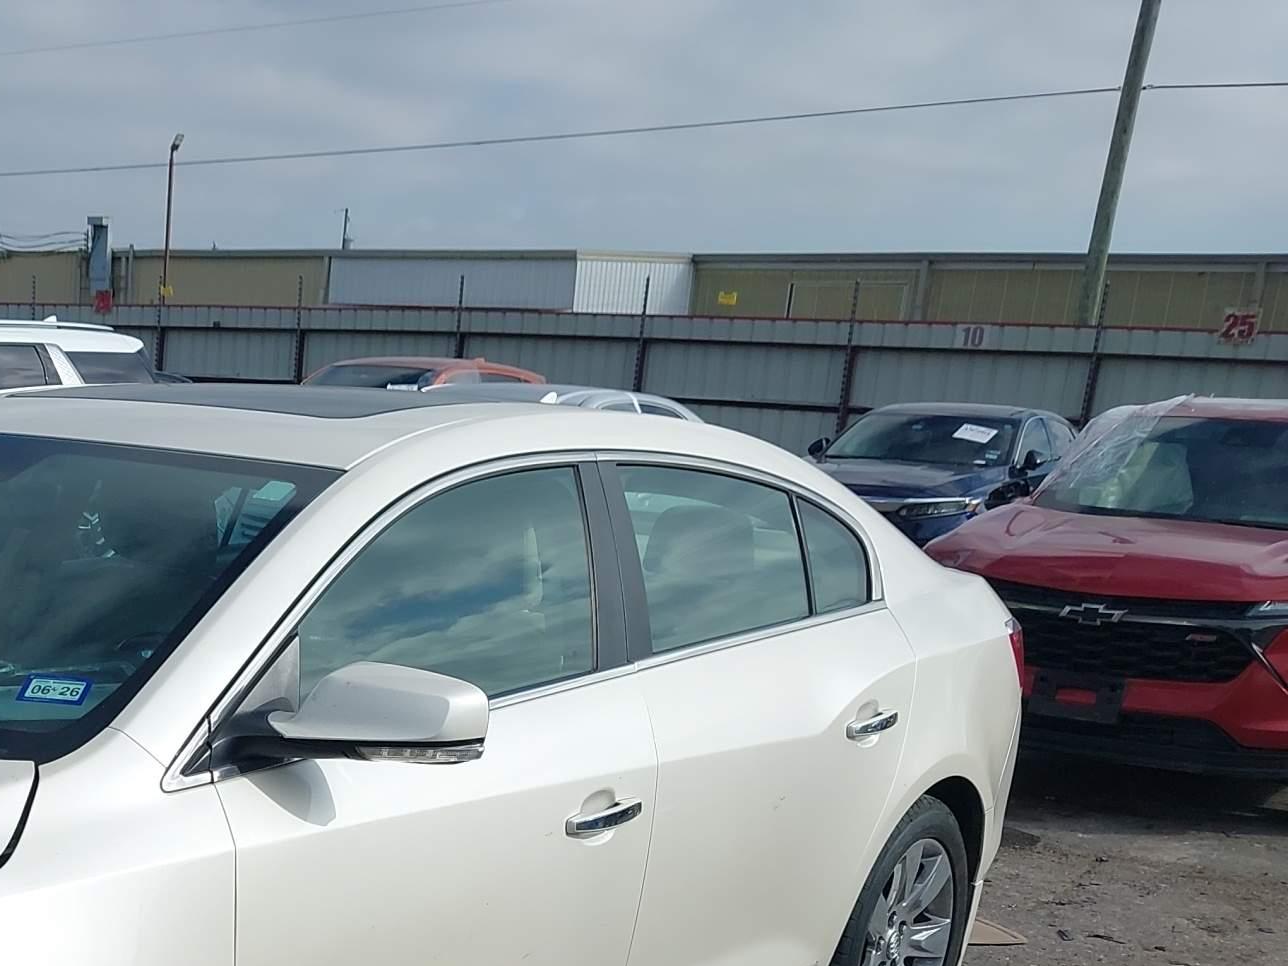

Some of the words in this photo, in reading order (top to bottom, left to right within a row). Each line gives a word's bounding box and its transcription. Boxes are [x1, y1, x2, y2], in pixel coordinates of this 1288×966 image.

[962, 326, 985, 348] 10
[1223, 312, 1256, 340] 25
[31, 684, 52, 695] 06
[58, 686, 81, 697] 26
